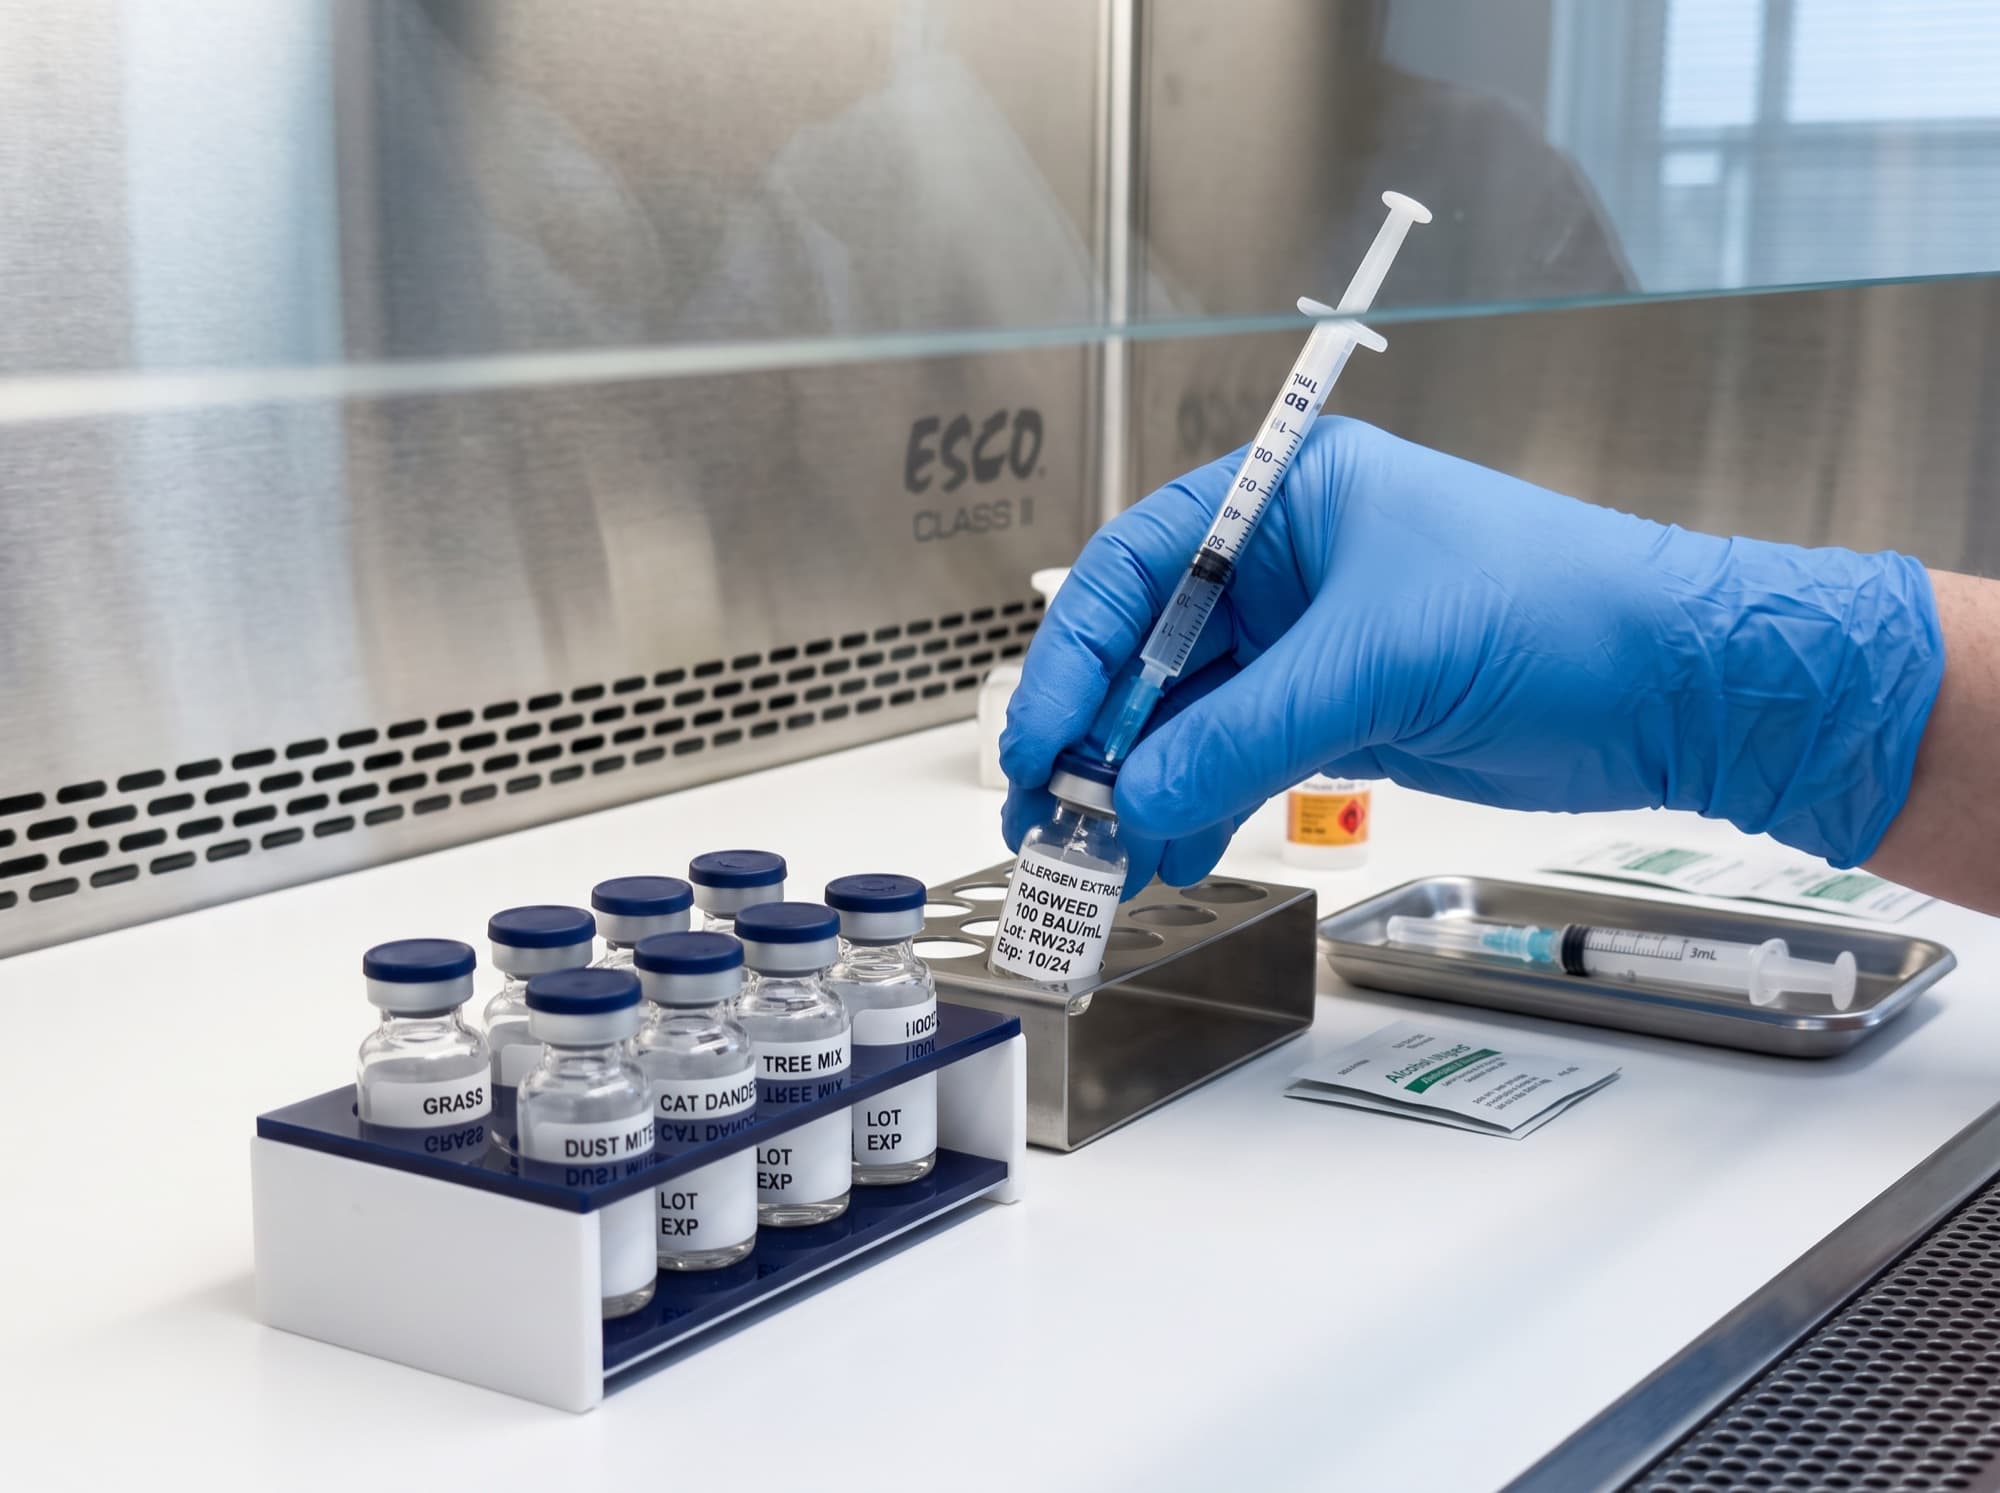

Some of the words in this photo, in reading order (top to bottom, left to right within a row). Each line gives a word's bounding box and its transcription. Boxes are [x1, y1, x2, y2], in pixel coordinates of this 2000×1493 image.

[1293, 373, 1317, 394] 1mL
[1284, 392, 1309, 412] BD
[905, 408, 1043, 493] ESCO
[914, 500, 1012, 541] CLASS
[1223, 506, 1241, 521] 40
[1207, 535, 1225, 550] 50
[1020, 859, 1078, 888] ALLERGEN
[1018, 882, 1098, 918] RAGWEED
[1016, 902, 1038, 922] 100
[1042, 912, 1102, 939] BAU/mL
[1003, 918, 1026, 940] Lot:
[1029, 929, 1086, 957] RW234
[997, 937, 1023, 961] Exp:
[1028, 950, 1071, 974] 10/24
[1689, 947, 1717, 960] 3mL
[763, 1055, 812, 1073] TREE
[818, 1047, 843, 1070] MIX
[423, 1087, 483, 1115] GRASS
[660, 1094, 699, 1112] CAT
[867, 1109, 902, 1127] LOT
[565, 1136, 620, 1158] DUST
[867, 1133, 902, 1150] EXP
[757, 1148, 792, 1166] LOT
[757, 1172, 792, 1190] EXP
[660, 1192, 698, 1210] LOT
[661, 1218, 699, 1236] EXP
